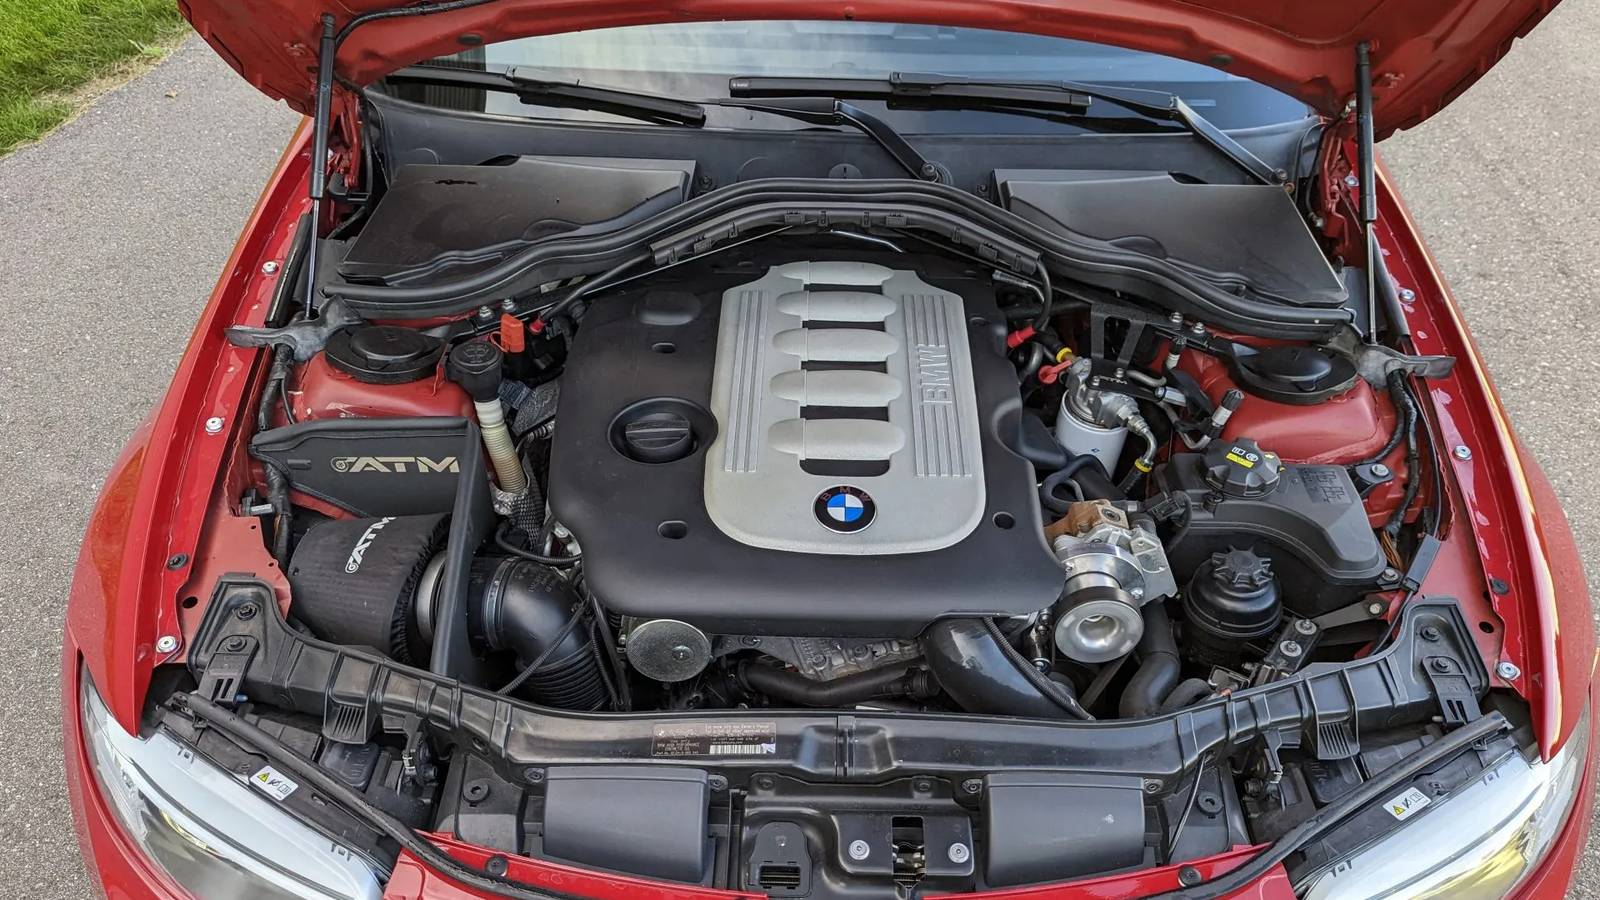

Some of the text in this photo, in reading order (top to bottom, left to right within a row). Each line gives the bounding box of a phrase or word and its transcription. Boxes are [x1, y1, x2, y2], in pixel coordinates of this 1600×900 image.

[918, 344, 952, 404] BMW
[347, 456, 460, 473] ATM
[820, 486, 871, 503] BMW
